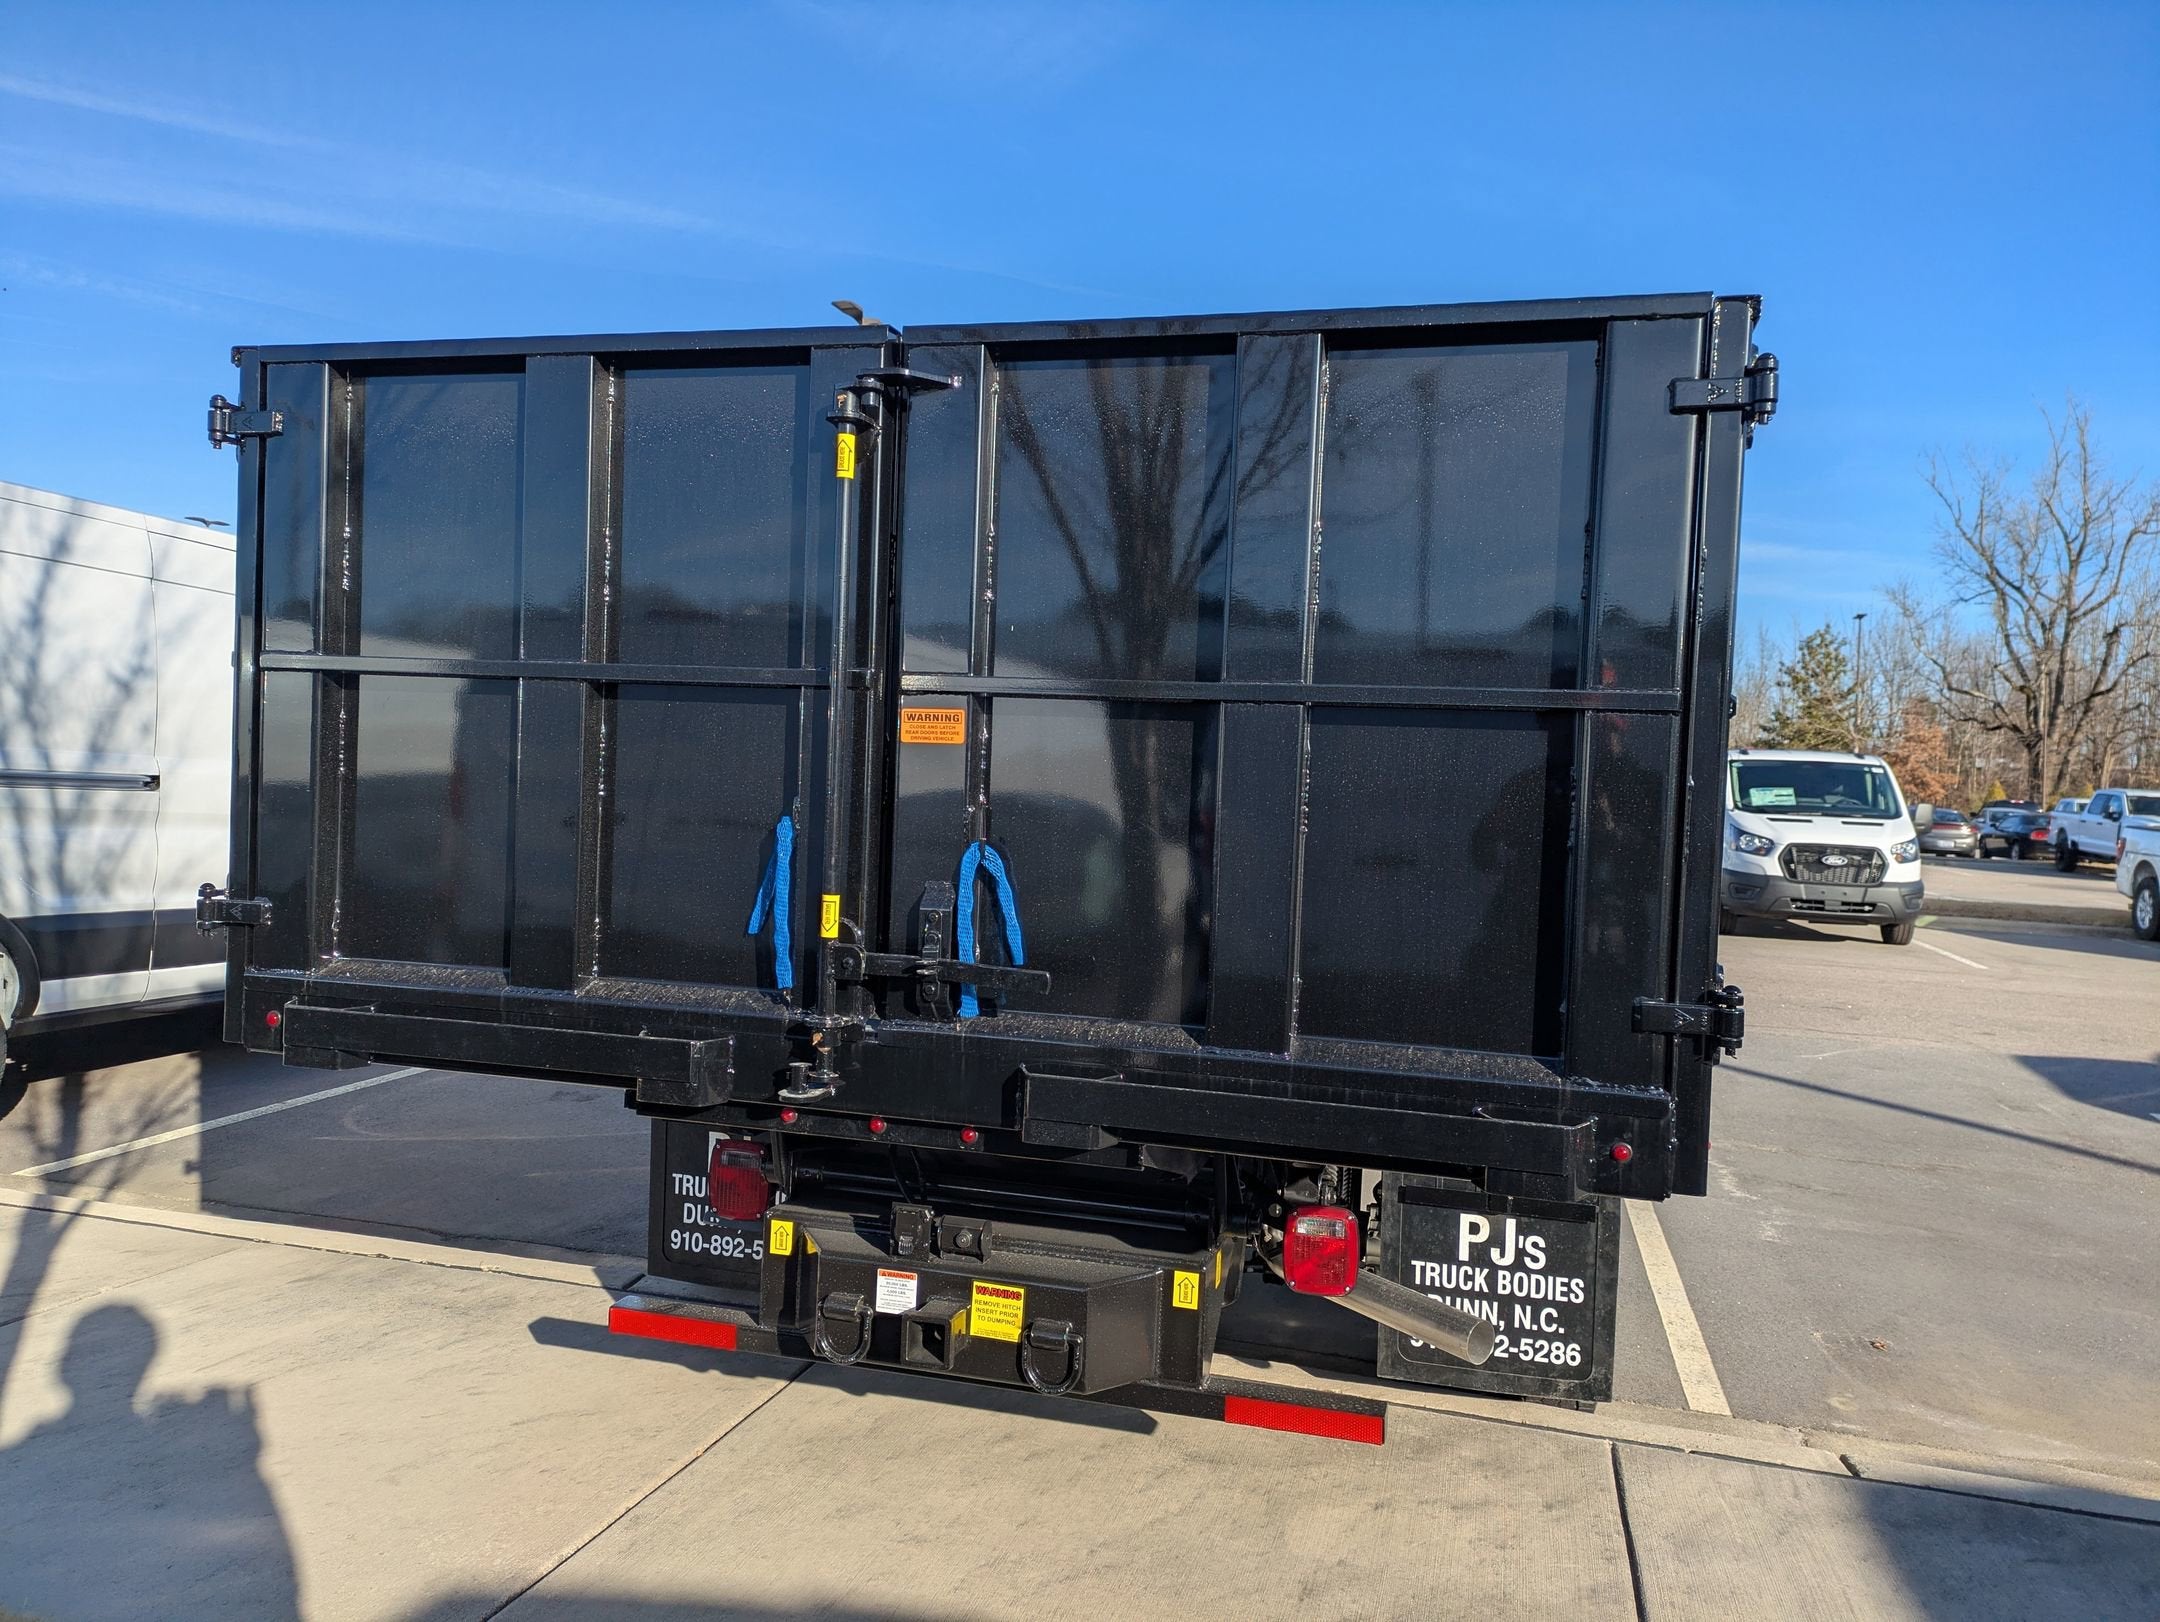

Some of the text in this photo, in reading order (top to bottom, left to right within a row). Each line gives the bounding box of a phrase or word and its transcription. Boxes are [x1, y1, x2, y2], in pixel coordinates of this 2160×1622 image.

[906, 713, 960, 722] WARNING
[886, 1271, 914, 1280] WARNING
[1411, 1260, 1585, 1303] TRUCK BODIES
[975, 1284, 1022, 1301] WARNING
[975, 1299, 1021, 1311] REMOVE HITCH
[976, 1307, 1018, 1318] INSERT PRIOR
[987, 1316, 1016, 1326] DUMPING
[1514, 1303, 1566, 1334] N.C.
